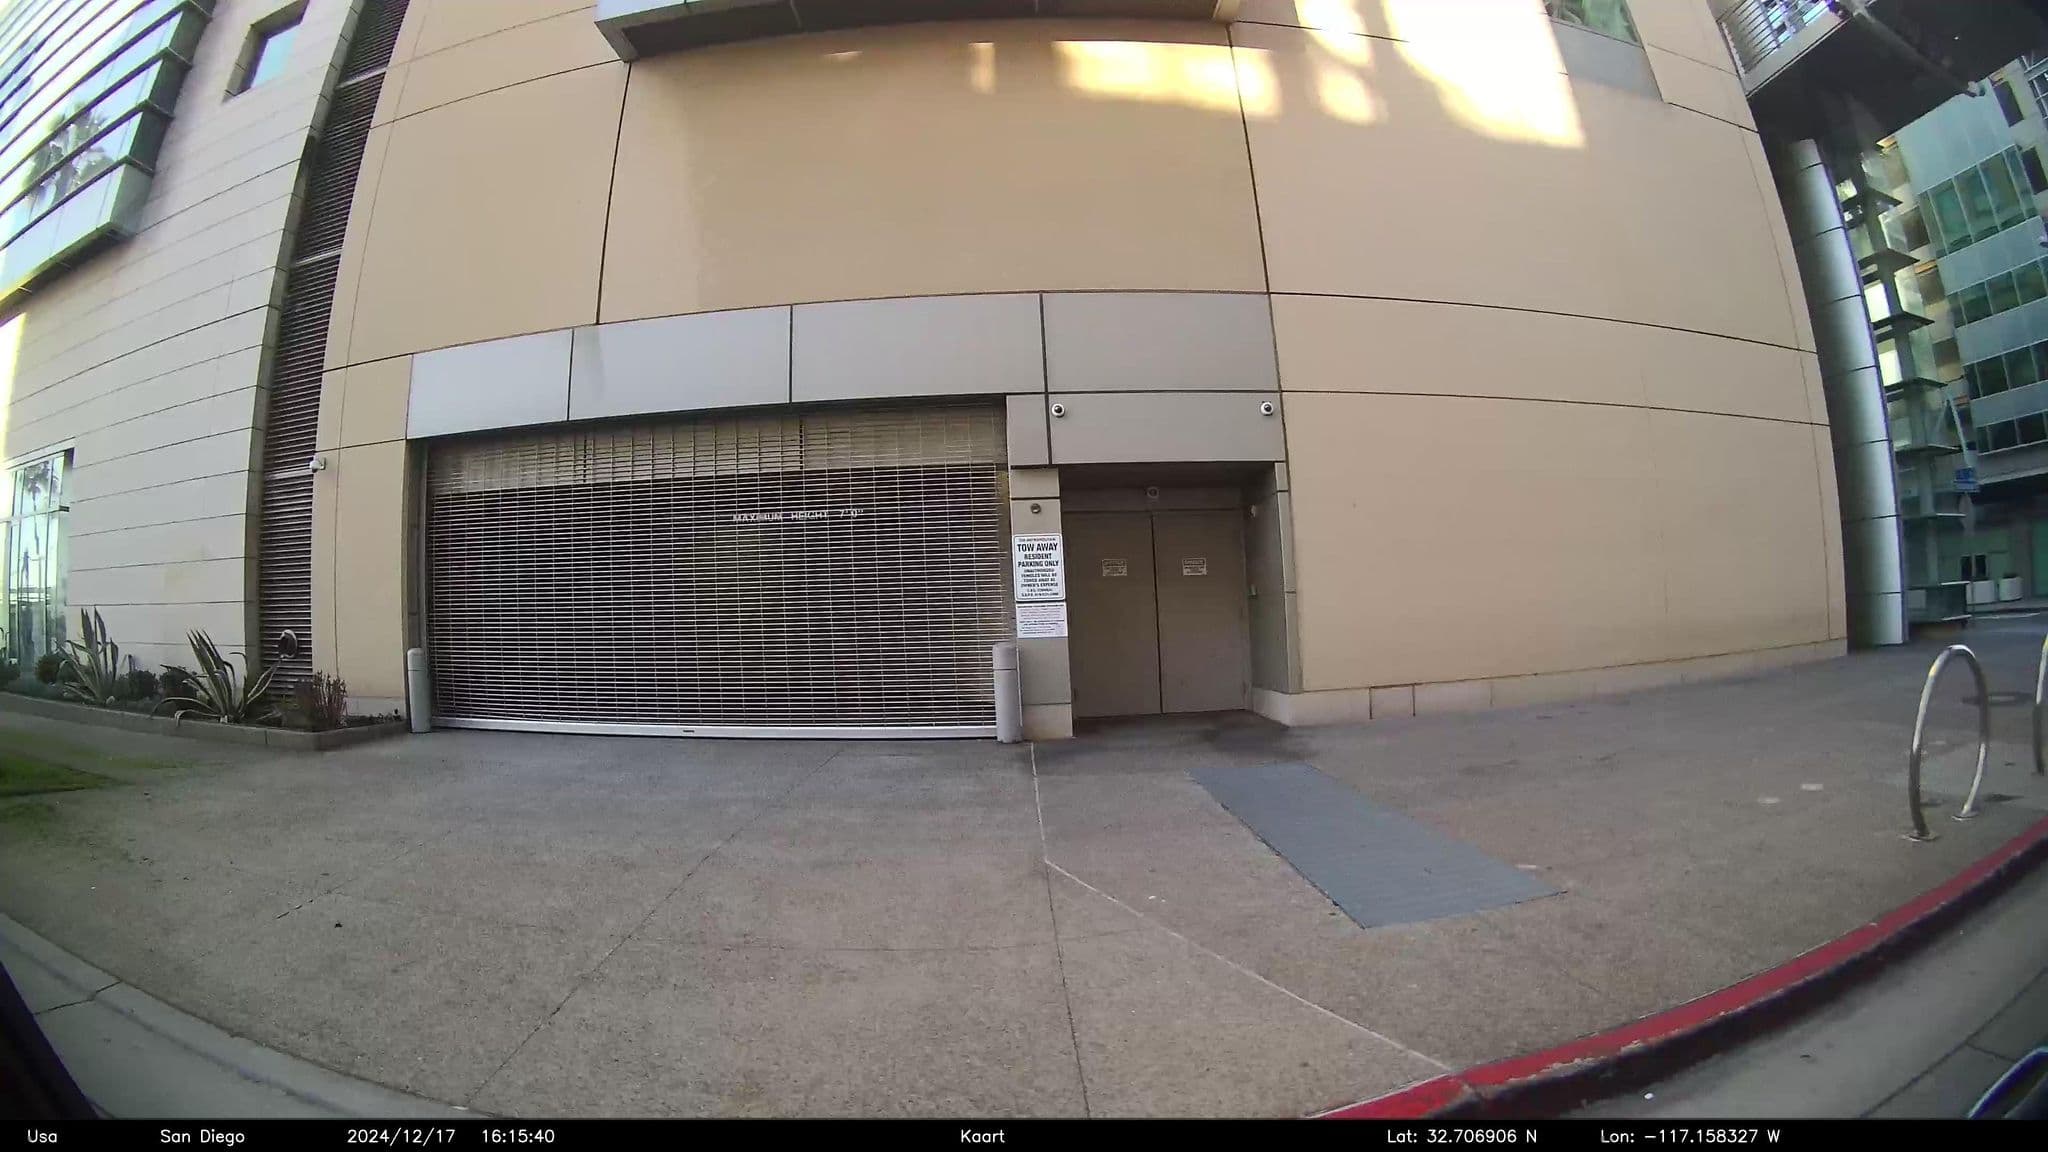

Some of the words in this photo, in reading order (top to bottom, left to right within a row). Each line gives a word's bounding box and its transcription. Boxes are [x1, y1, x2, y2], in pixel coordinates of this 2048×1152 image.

[1017, 543, 1035, 552] TOW
[1036, 542, 1058, 551] AWAY
[1018, 560, 1044, 568] PARKING
